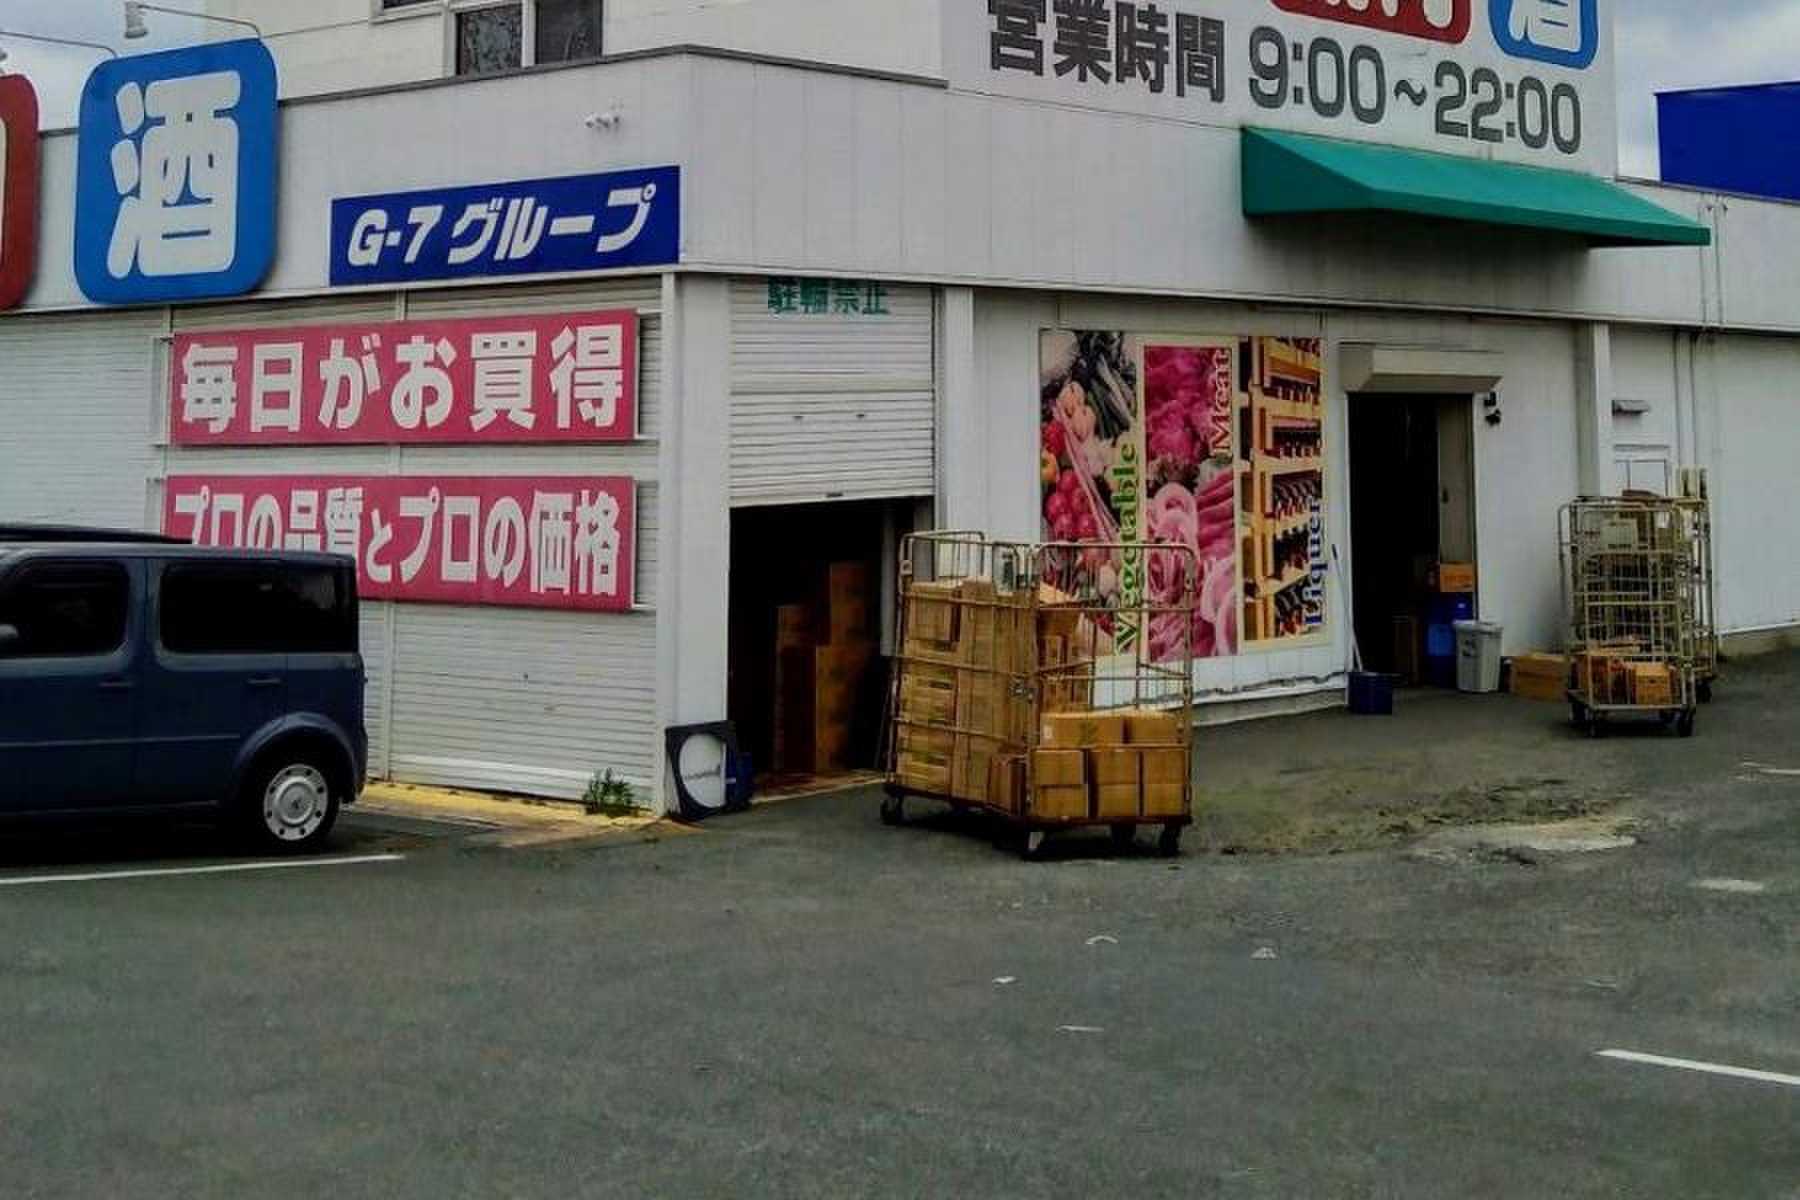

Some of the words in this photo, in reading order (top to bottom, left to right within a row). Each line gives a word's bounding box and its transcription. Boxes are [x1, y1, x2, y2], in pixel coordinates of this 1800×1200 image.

[108, 70, 241, 278] 酒
[180, 323, 623, 433] 毎日がお買得
[1208, 349, 1231, 456] Meat
